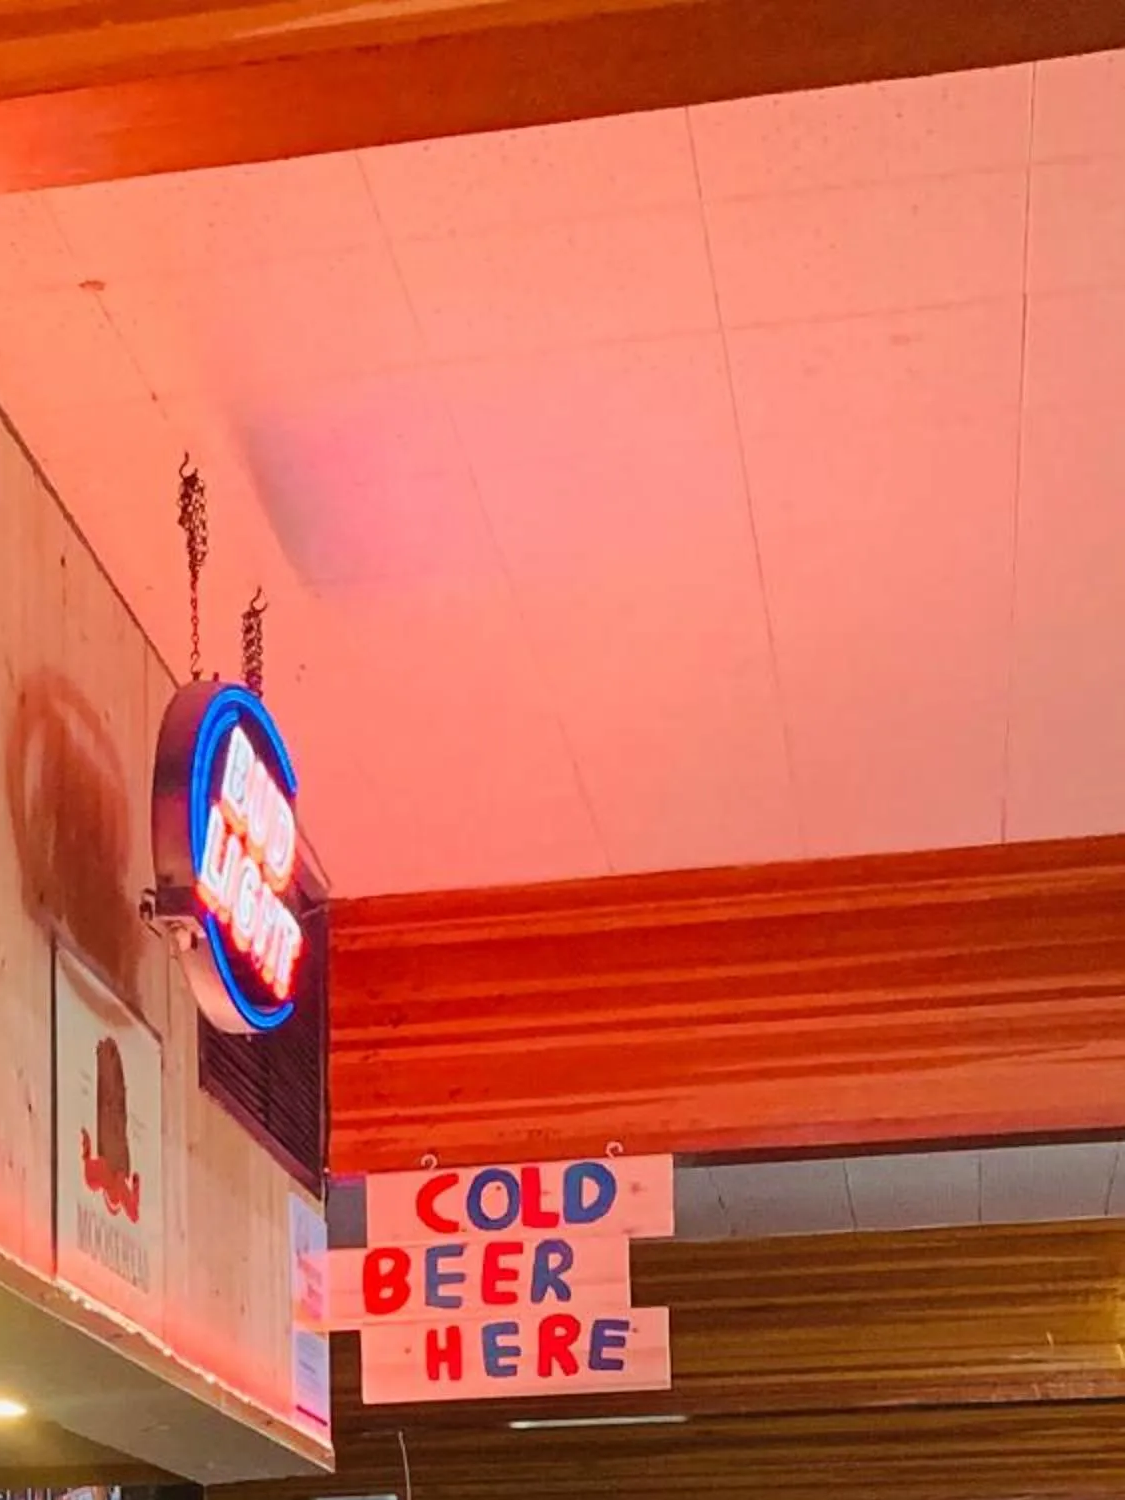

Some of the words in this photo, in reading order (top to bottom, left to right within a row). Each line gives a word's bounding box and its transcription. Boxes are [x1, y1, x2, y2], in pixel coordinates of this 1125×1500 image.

[222, 725, 296, 882] BUD
[199, 804, 302, 990] LIGHT
[416, 1162, 617, 1233] COLD
[363, 1239, 574, 1314] BEER
[425, 1313, 630, 1381] HERE
